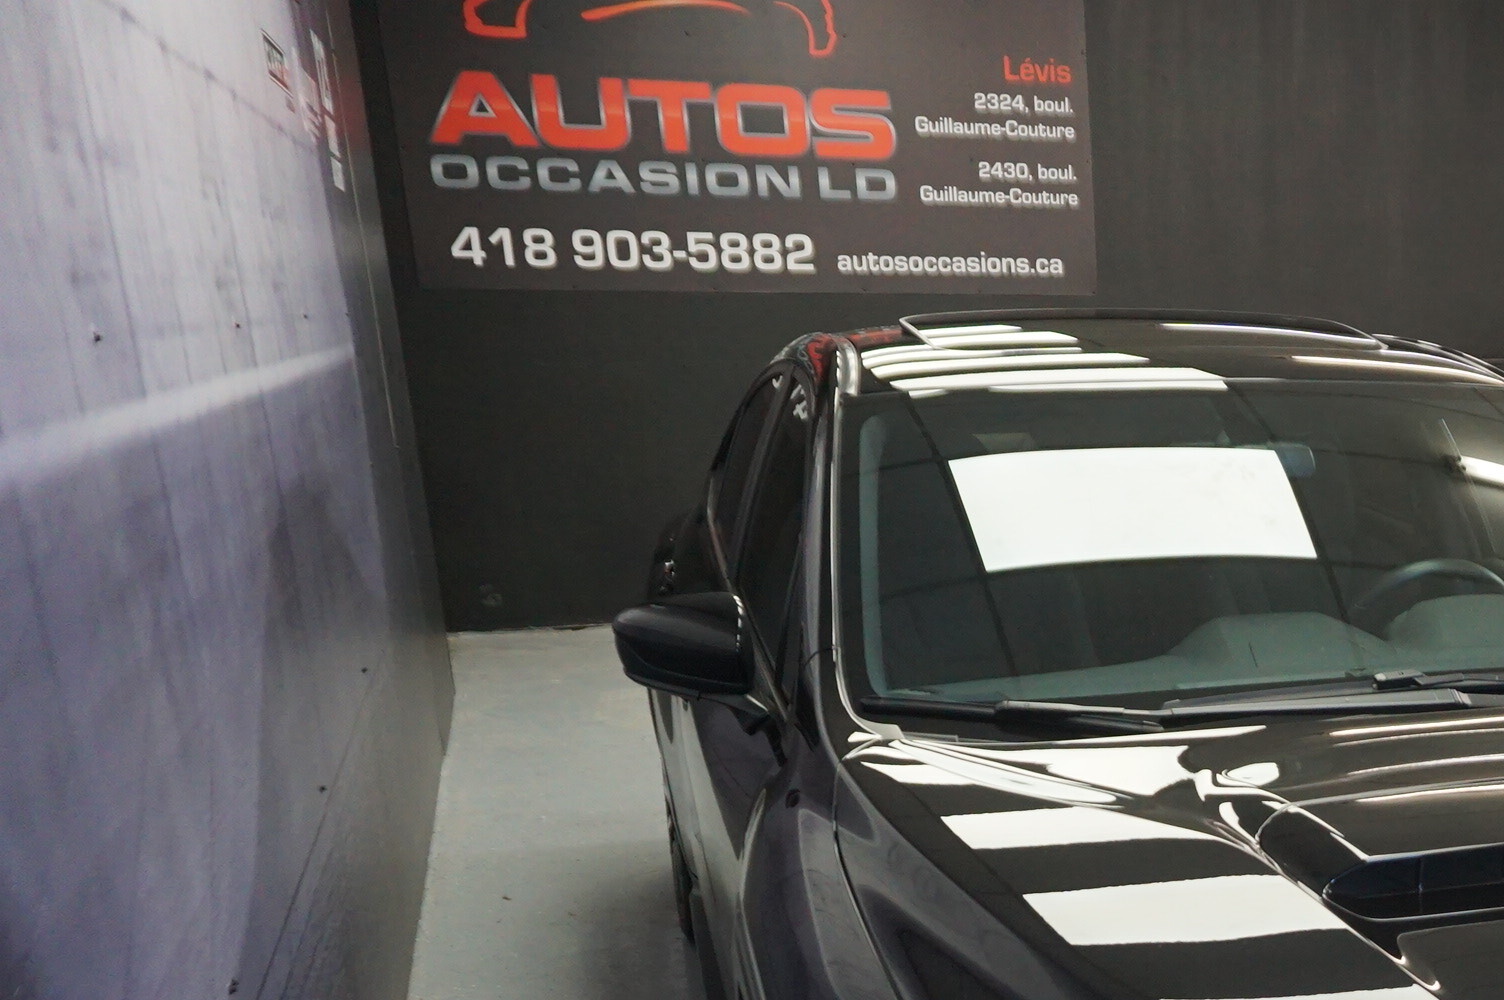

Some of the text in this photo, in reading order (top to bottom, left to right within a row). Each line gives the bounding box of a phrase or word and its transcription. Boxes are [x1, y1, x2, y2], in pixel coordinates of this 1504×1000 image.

[1004, 55, 1073, 84] Lévis
[430, 70, 897, 161] AUTOS
[974, 92, 1074, 114] 2324, boul.
[915, 115, 1076, 140] Guillaume-Couture
[430, 154, 897, 200] OCCASION LD
[978, 161, 1078, 182] 2430, boul.
[919, 185, 1080, 208] Guillaume-Couture
[451, 226, 816, 275] 418 903-5882
[837, 251, 1065, 277] autosoccasions.ca
